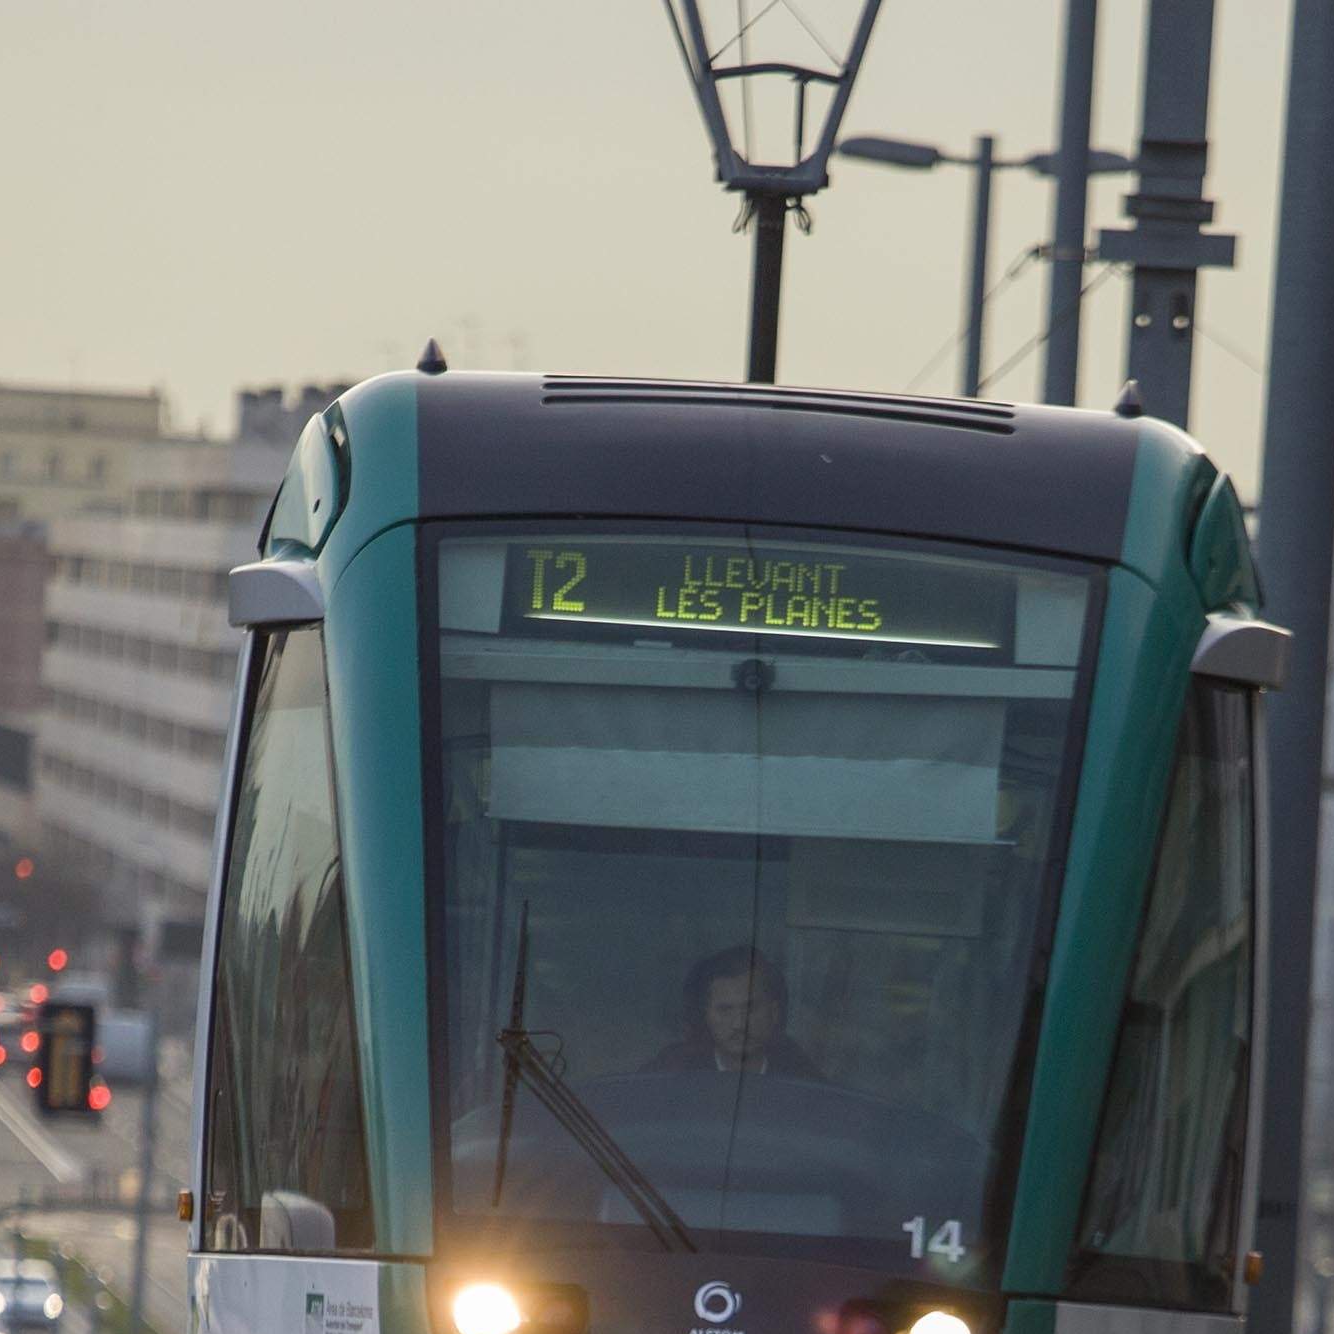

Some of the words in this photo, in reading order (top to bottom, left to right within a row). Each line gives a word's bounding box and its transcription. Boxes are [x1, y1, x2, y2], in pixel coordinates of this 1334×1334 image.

[526, 549, 587, 612] T2
[684, 554, 847, 593] LLEVANT
[657, 585, 722, 621] LES
[739, 591, 882, 630] PLANES
[902, 1215, 965, 1263] 14
